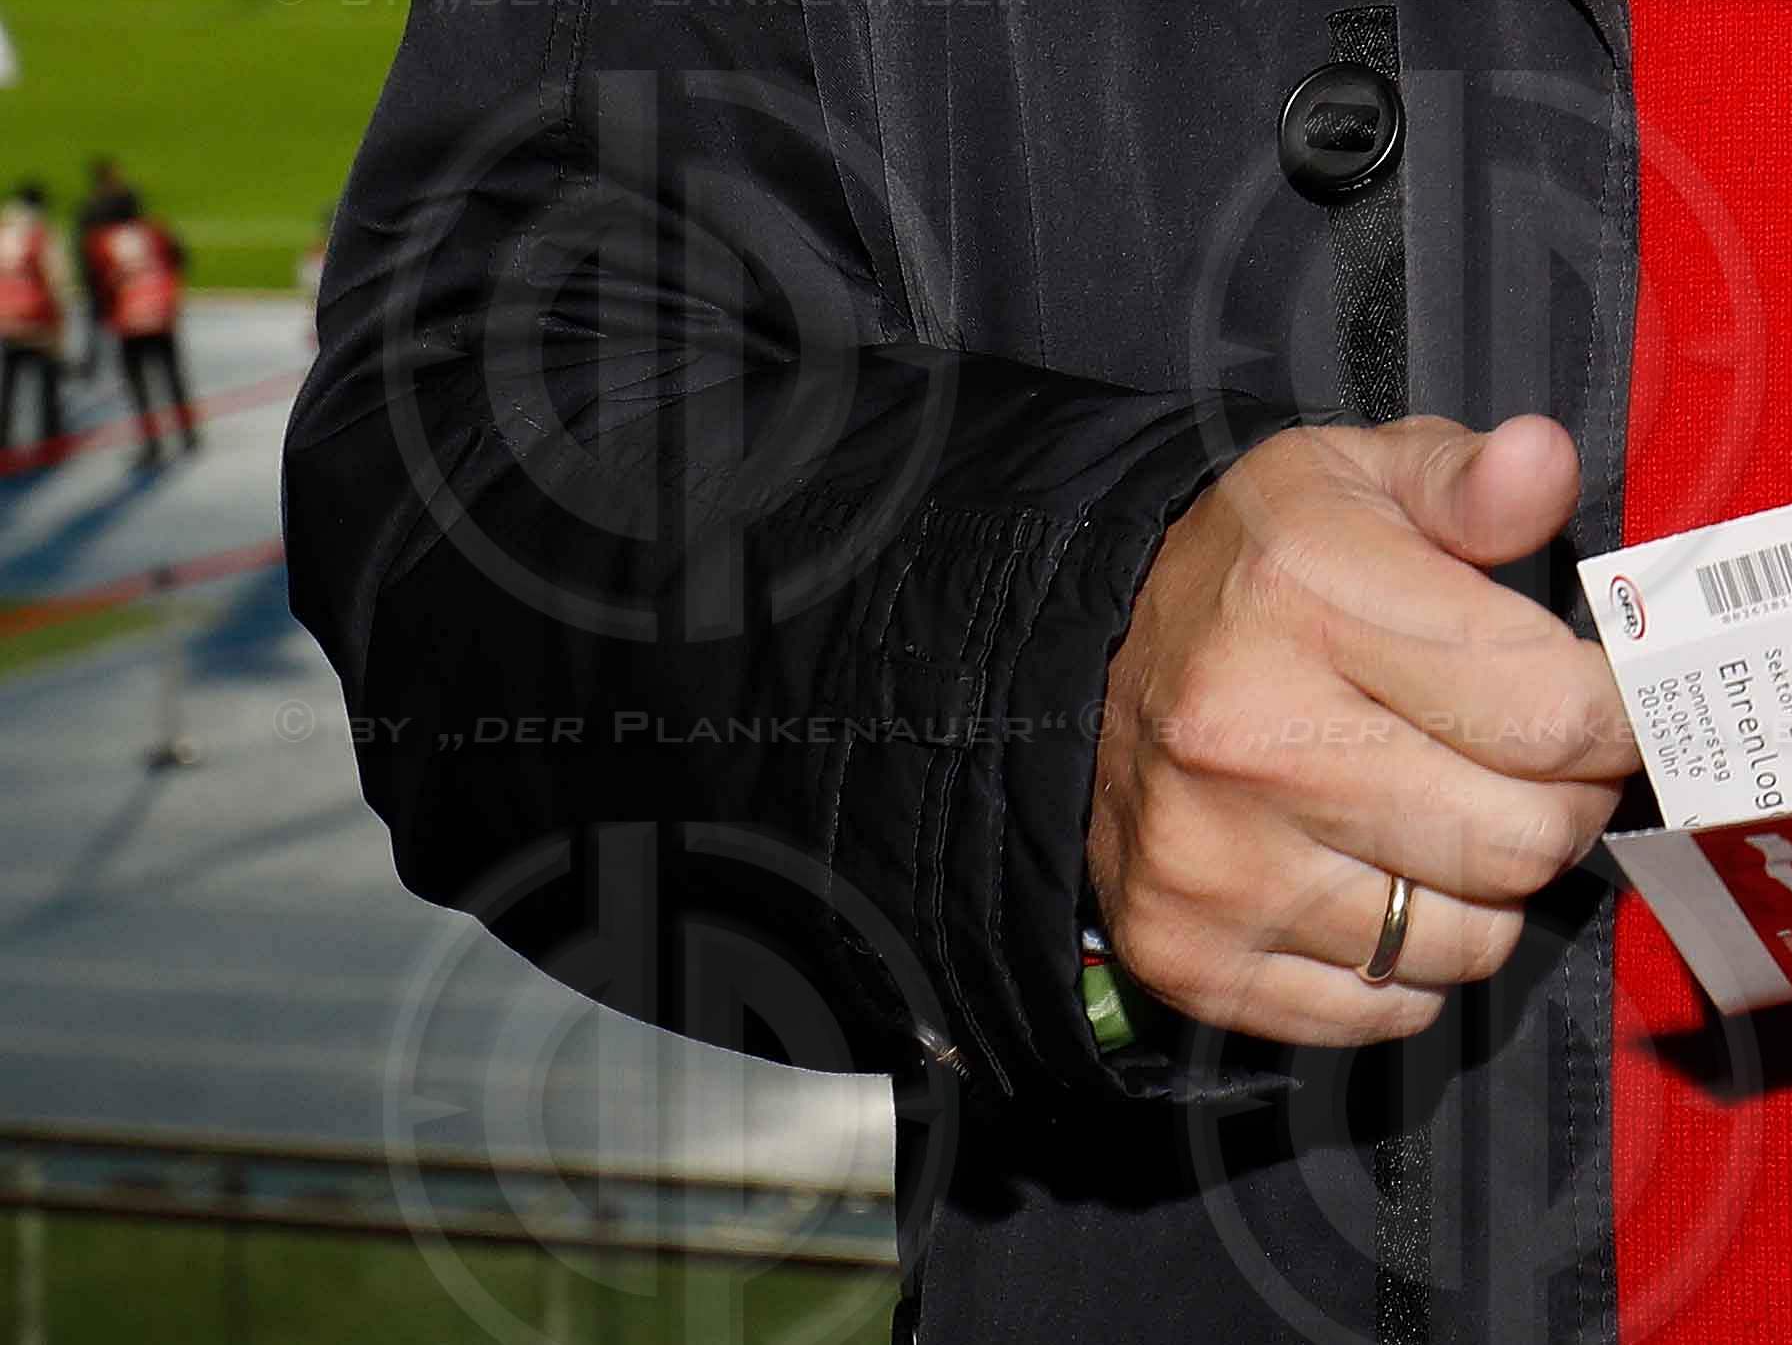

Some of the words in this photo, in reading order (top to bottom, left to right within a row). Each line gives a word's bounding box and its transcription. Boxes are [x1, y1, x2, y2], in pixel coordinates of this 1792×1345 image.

[1637, 685, 1672, 741] 20:45
[1657, 745, 1680, 780] Uhr
[1684, 670, 1731, 783] Donnerstag
